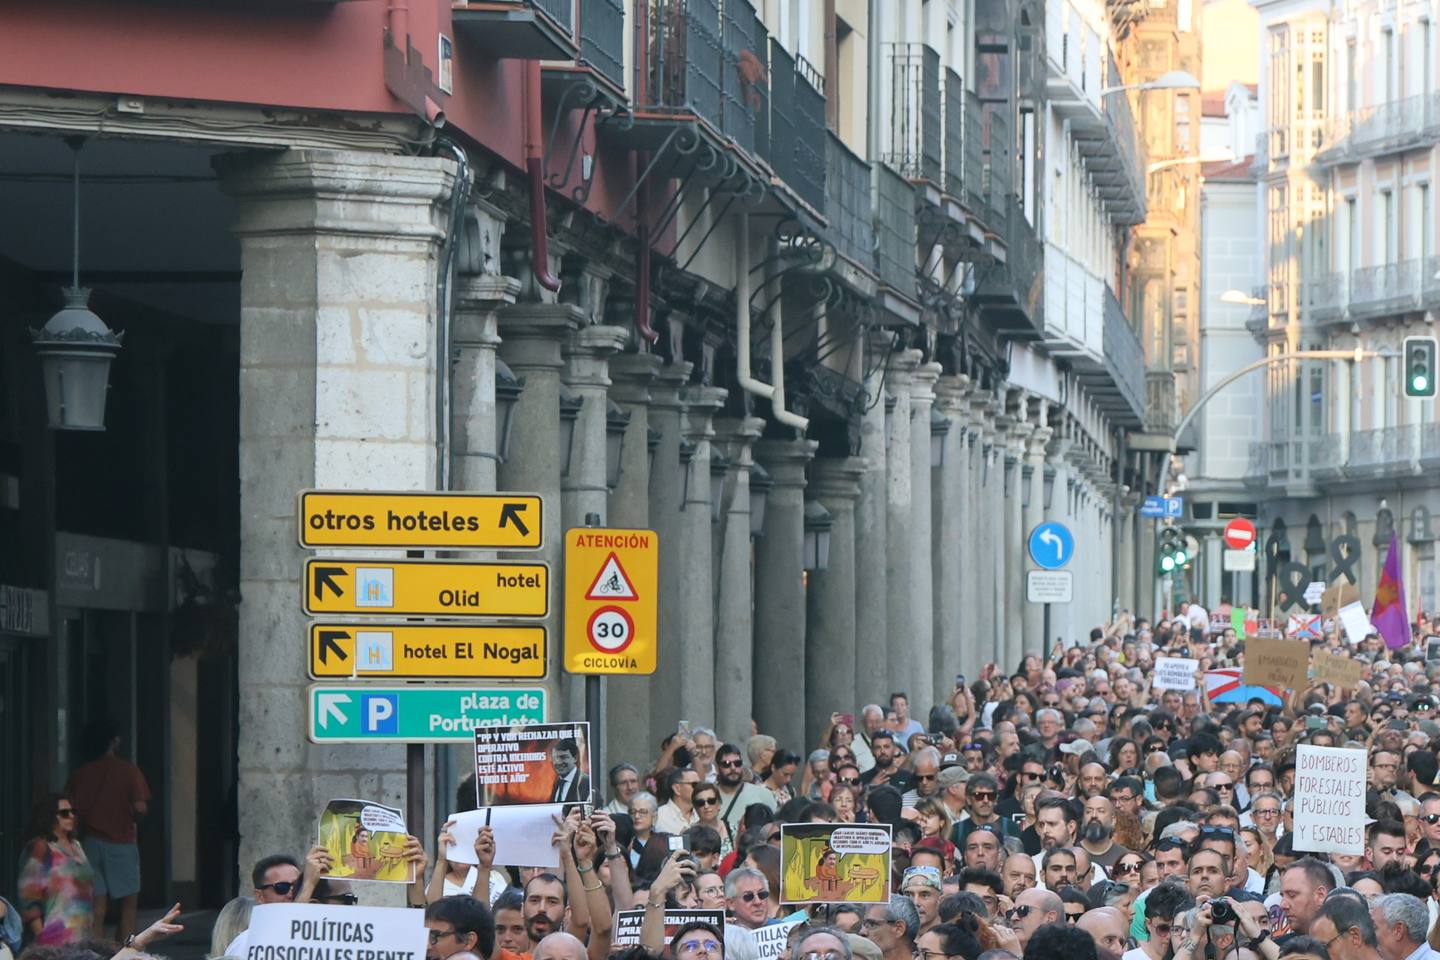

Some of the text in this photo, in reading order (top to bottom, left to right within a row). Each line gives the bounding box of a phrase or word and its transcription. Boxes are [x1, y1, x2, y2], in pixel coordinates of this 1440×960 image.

[310, 510, 479, 531] otros hoteles
[576, 533, 649, 549] ATENCIÓN
[497, 573, 540, 588] hotel
[439, 590, 479, 607] Olid
[597, 622, 624, 638] 30
[403, 643, 539, 663] hotel El Nogal
[584, 656, 638, 669] CICLOVÍA
[460, 693, 539, 713] plaza de
[368, 698, 393, 731] P
[1301, 754, 1357, 773] BOMBEROS
[1299, 776, 1361, 798] FORESTALES
[1301, 795, 1351, 816] PÚBLICOS
[1300, 825, 1361, 844] Y ESTABLES
[290, 918, 374, 943] POLÍTICAS
[755, 926, 788, 942] TILLAS
